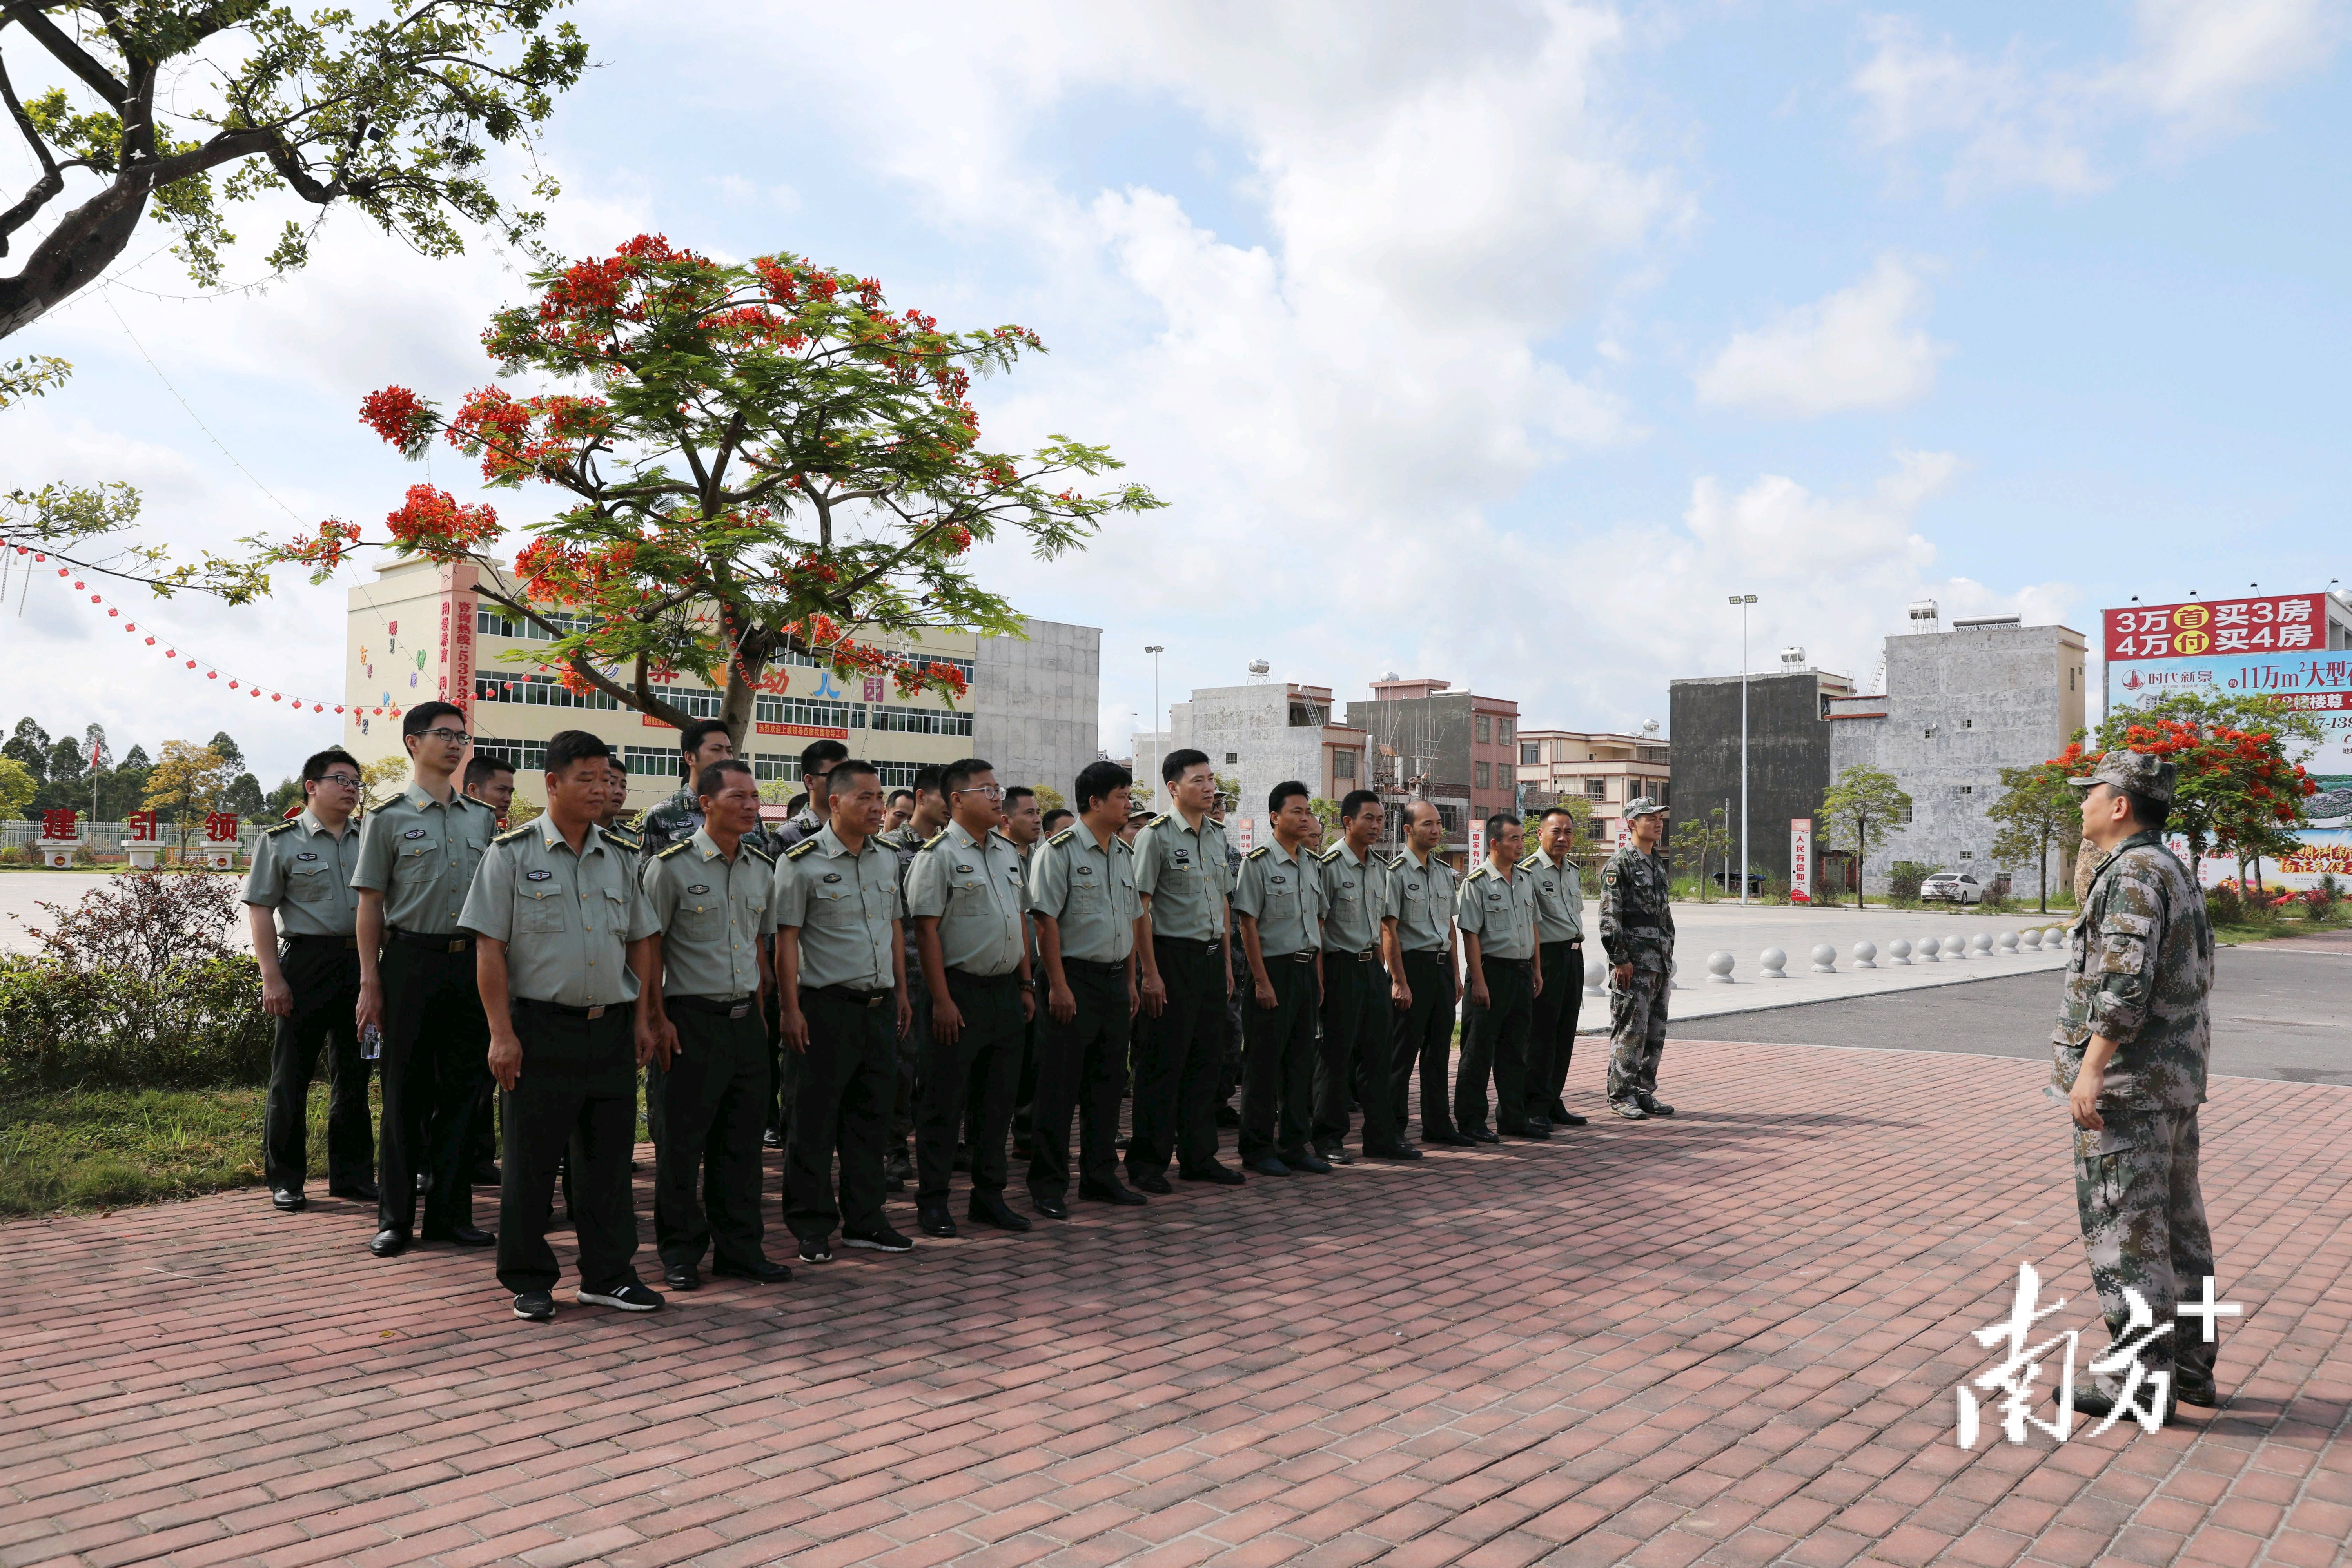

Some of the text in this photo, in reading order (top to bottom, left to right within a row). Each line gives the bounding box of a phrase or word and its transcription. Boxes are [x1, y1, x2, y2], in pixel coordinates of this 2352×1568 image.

[2149, 670, 2212, 684] 时代新景
[42, 808, 238, 841] 建 引 领
[1795, 835, 1805, 881] 人民有信仰
